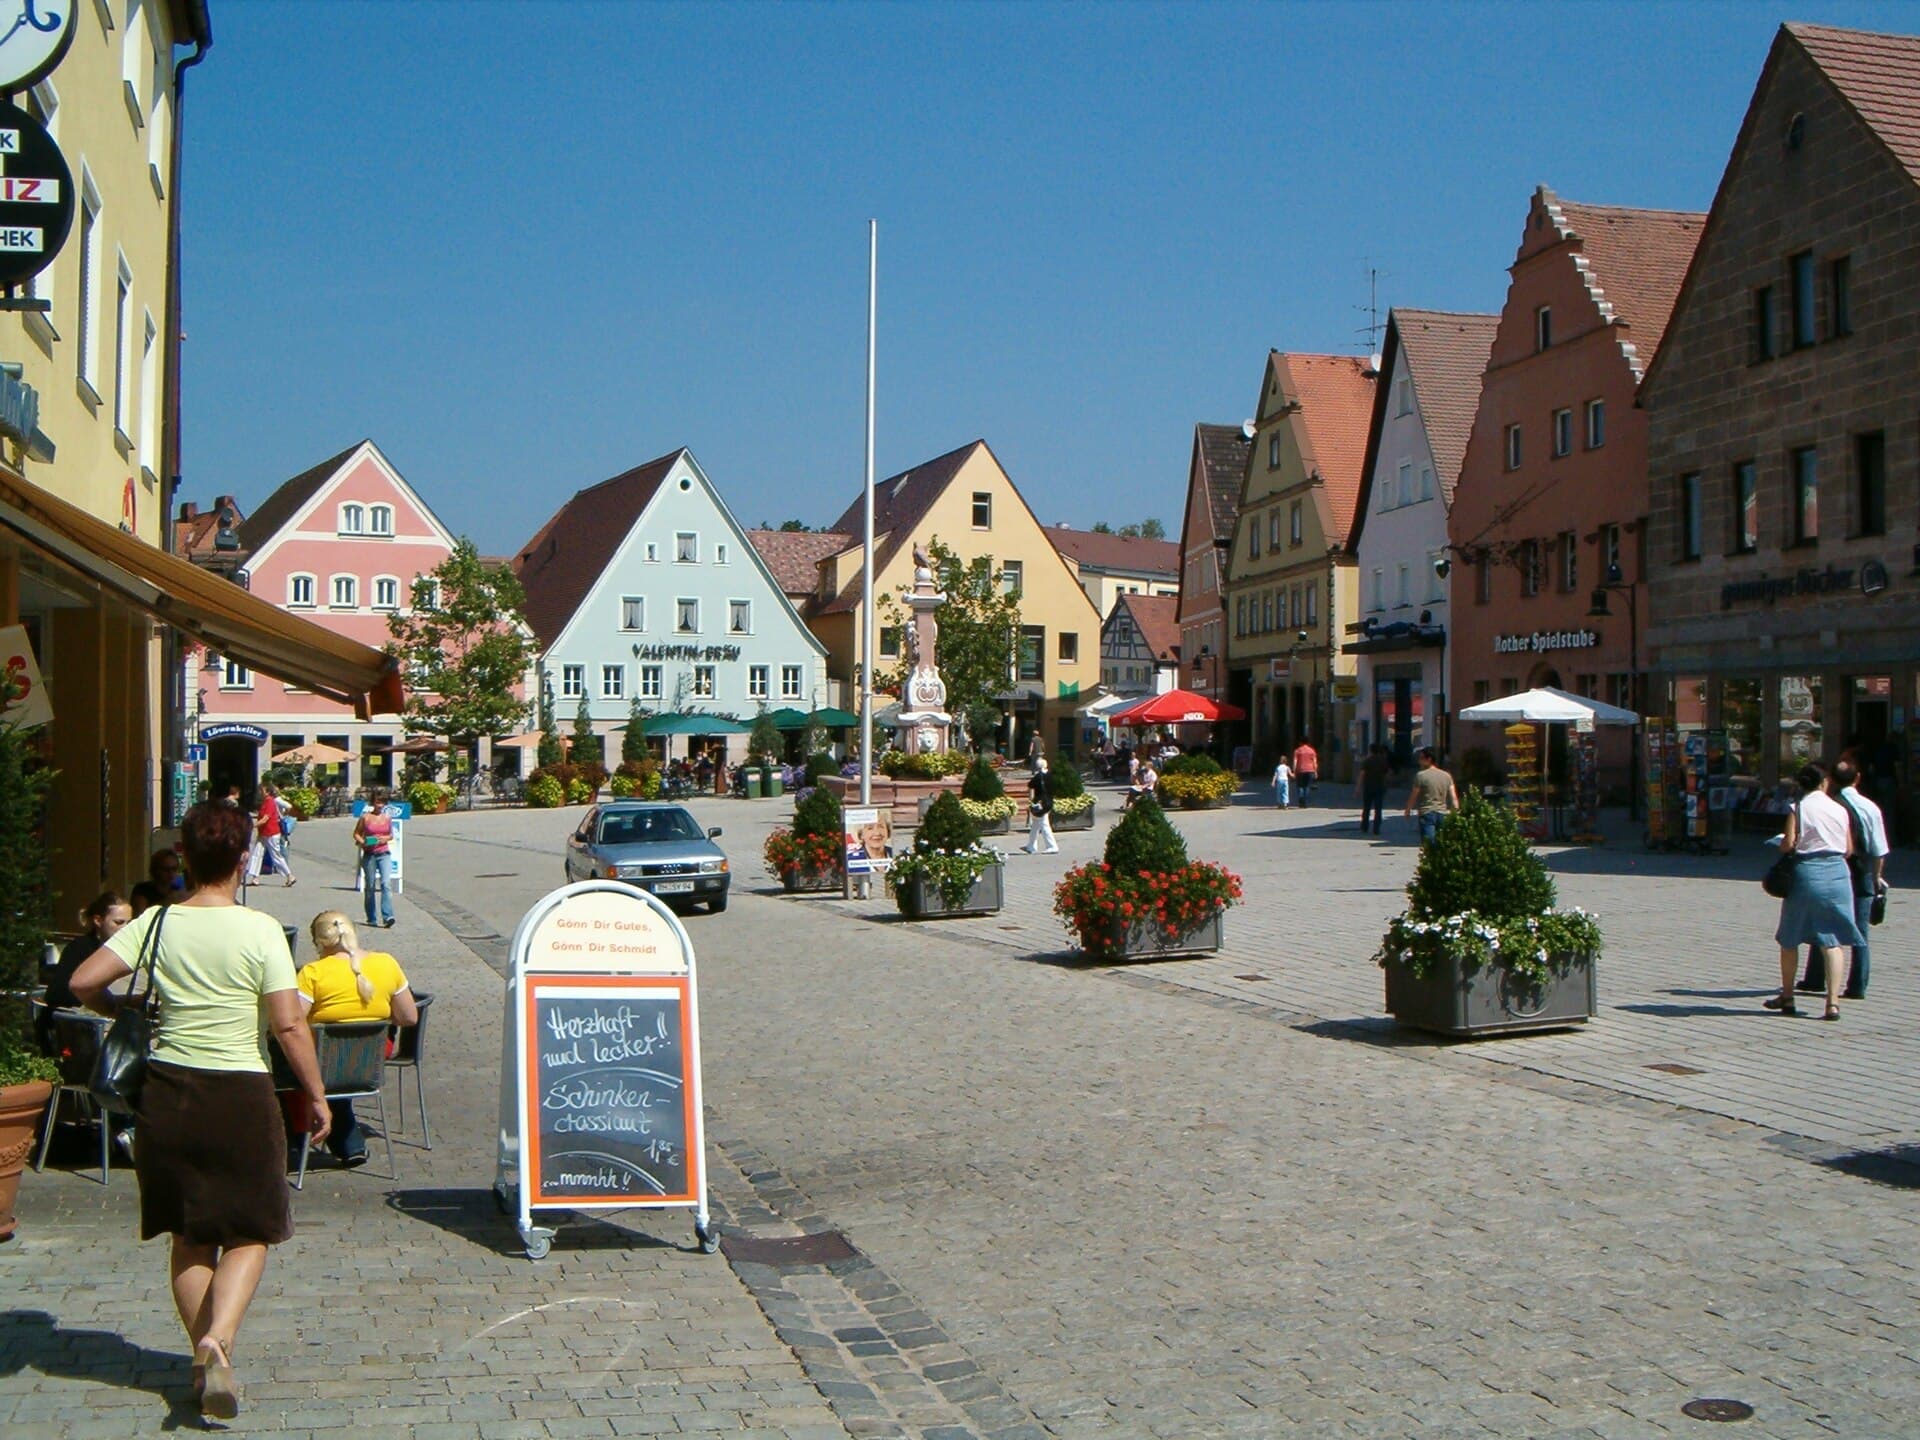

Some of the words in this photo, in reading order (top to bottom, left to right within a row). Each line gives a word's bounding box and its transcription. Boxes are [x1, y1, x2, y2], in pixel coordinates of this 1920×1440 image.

[1494, 635, 1530, 653] Rother
[1531, 628, 1597, 654] Spielstube
[206, 724, 263, 738] Löwenkeller
[594, 919, 611, 930] Dir
[588, 941, 606, 953] Dir
[609, 943, 657, 954] Schmidt
